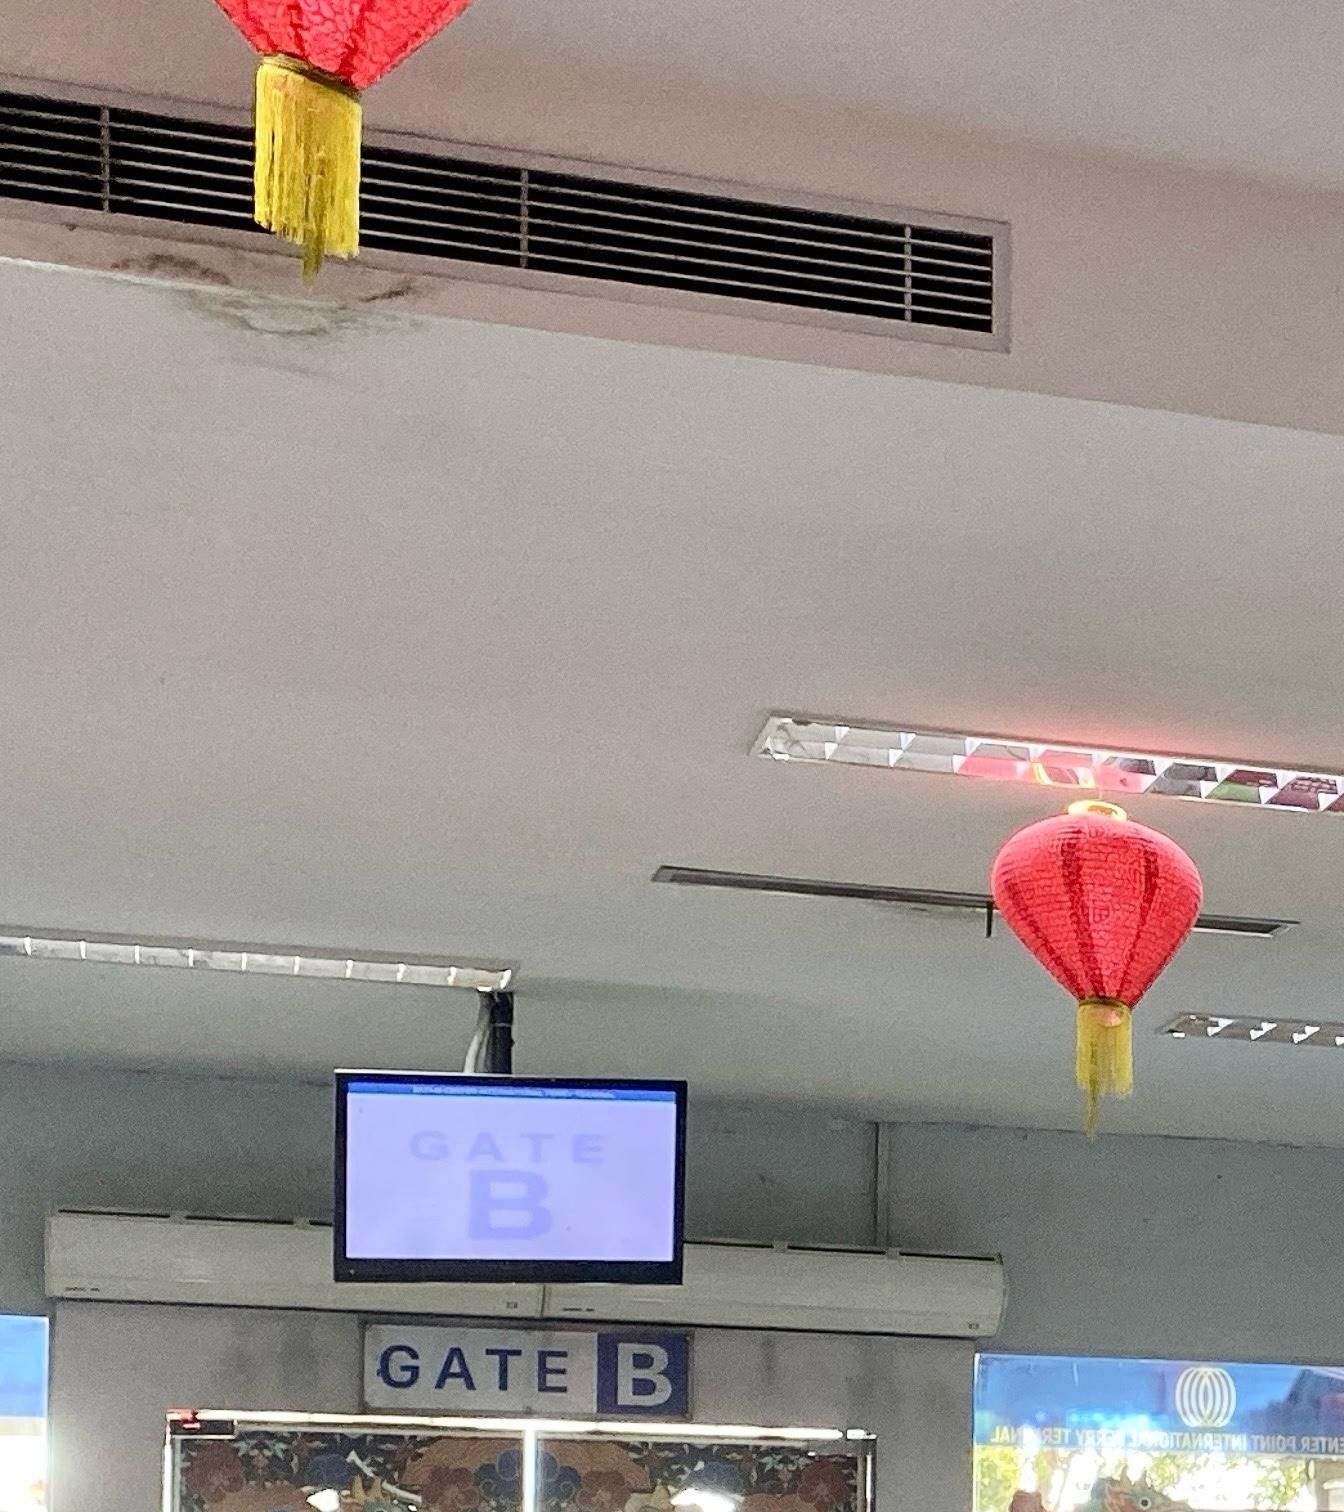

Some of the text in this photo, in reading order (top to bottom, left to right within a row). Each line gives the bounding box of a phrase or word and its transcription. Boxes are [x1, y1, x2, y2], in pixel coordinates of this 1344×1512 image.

[409, 1130, 605, 1164] GATE
[469, 1169, 553, 1240] B
[377, 1342, 673, 1407] GATE B
